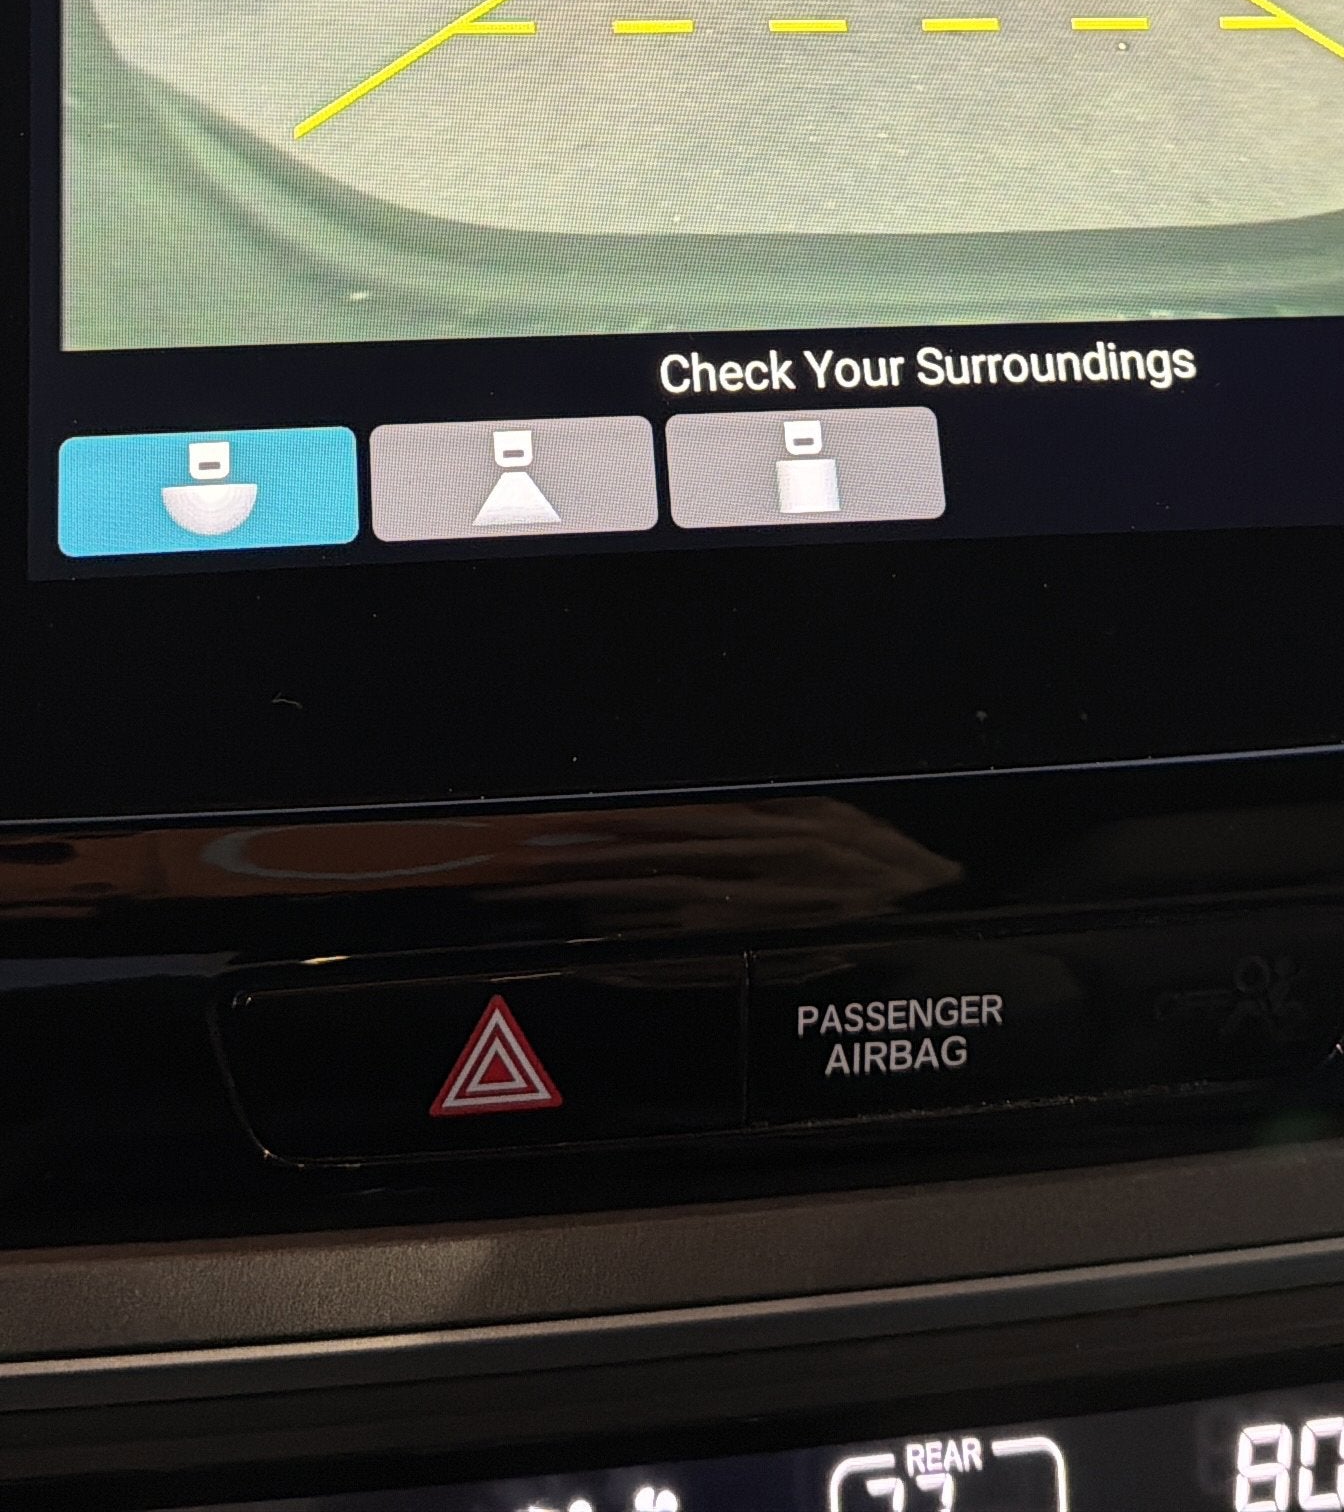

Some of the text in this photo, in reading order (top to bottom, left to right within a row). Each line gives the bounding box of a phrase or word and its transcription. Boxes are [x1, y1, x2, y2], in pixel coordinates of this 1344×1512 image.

[659, 341, 1198, 394] Check Your Surroundings
[797, 993, 1004, 1038] PASSENGER
[824, 1035, 968, 1077] AIRBAG
[905, 1436, 983, 1477] REAR
